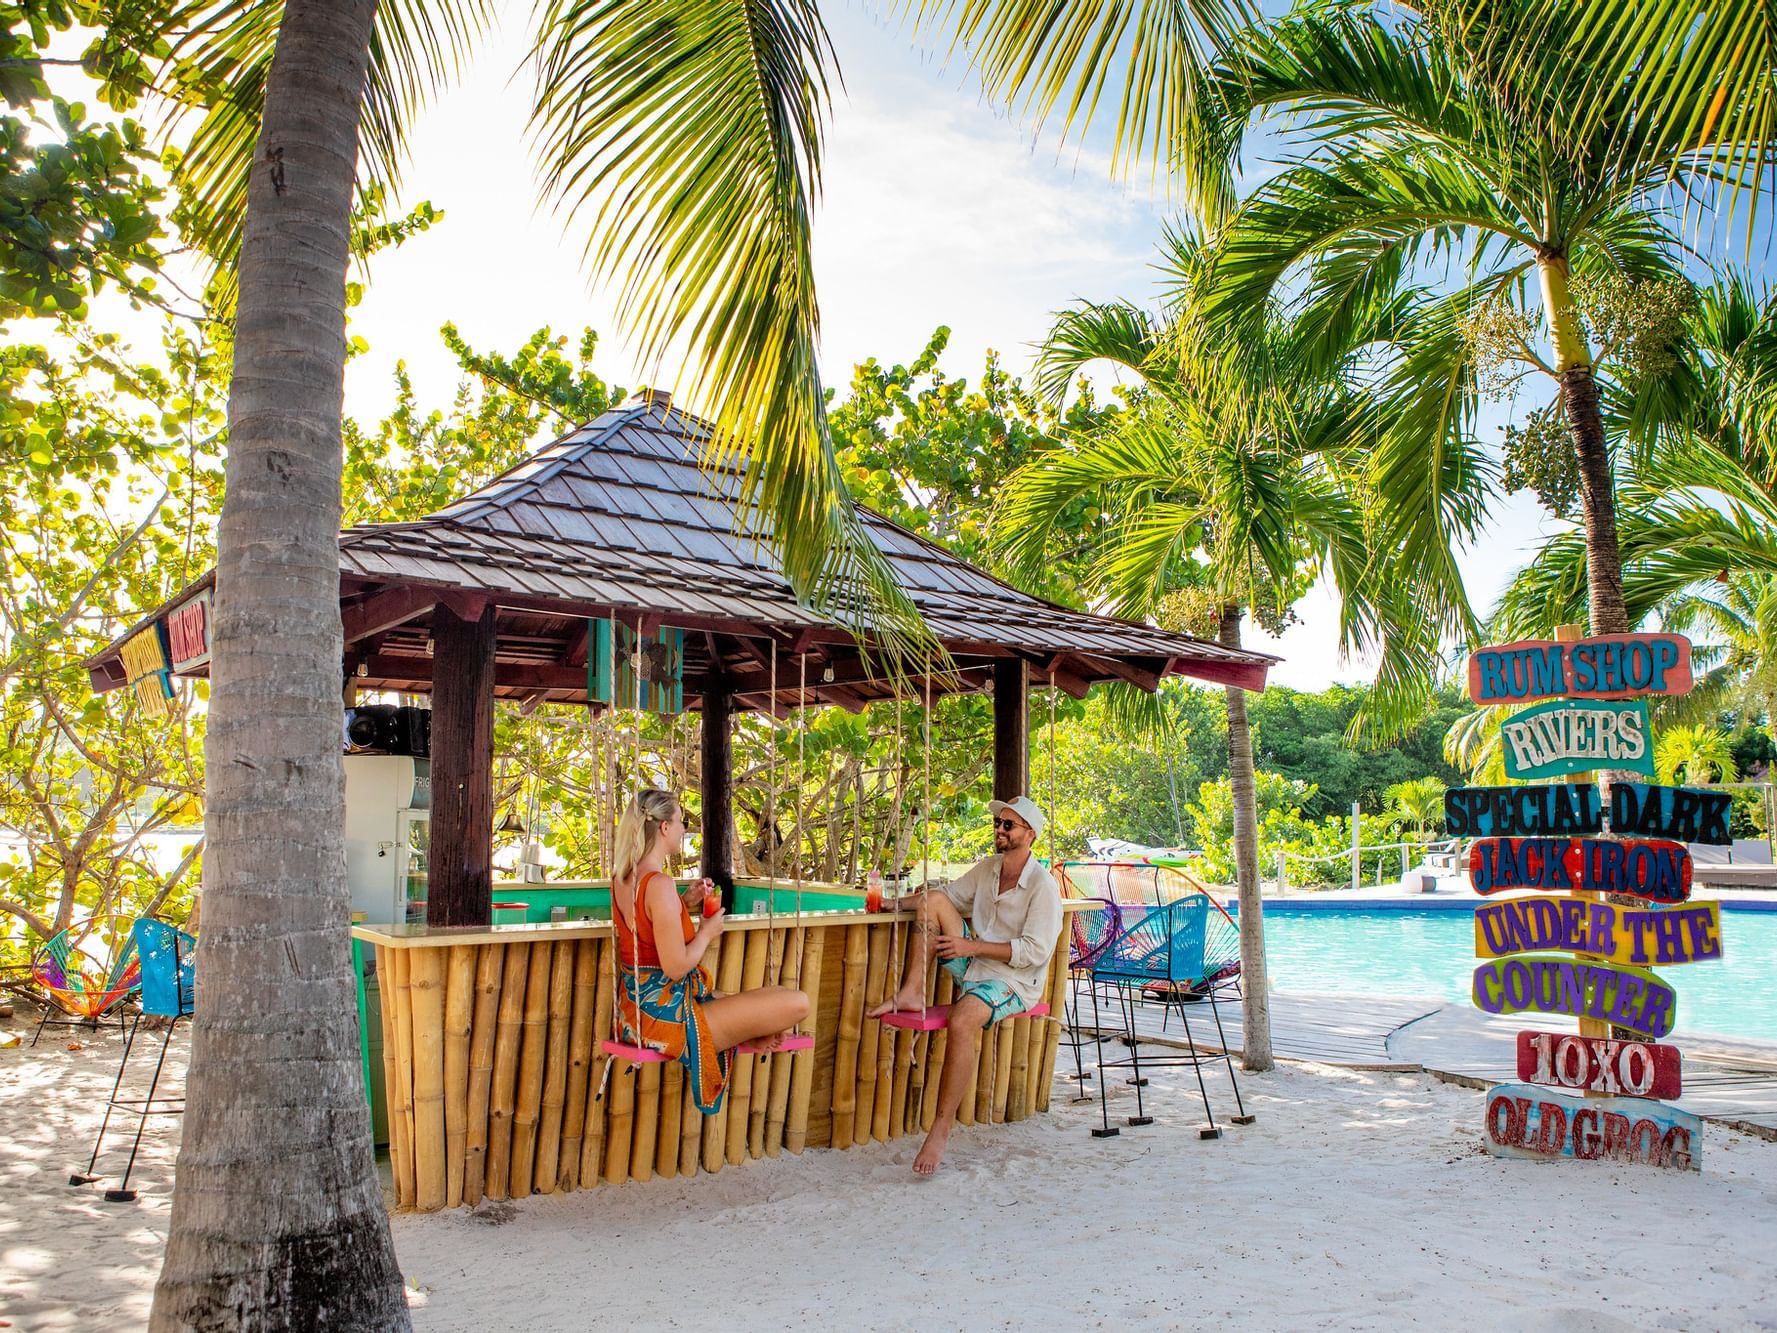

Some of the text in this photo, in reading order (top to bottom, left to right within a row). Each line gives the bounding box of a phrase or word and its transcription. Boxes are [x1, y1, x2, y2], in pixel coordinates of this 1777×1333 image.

[1477, 639, 1679, 699] RUM SHOP
[1503, 708, 1645, 772] RIVERS
[415, 776, 430, 788] FRIG
[1444, 782, 1733, 846] SPECIAL DARK
[1473, 839, 1687, 901] JACK IRON
[1476, 899, 1722, 964] UNDER THE
[1474, 960, 1675, 1039] COUNTER
[1487, 1095, 1567, 1155] OLD
